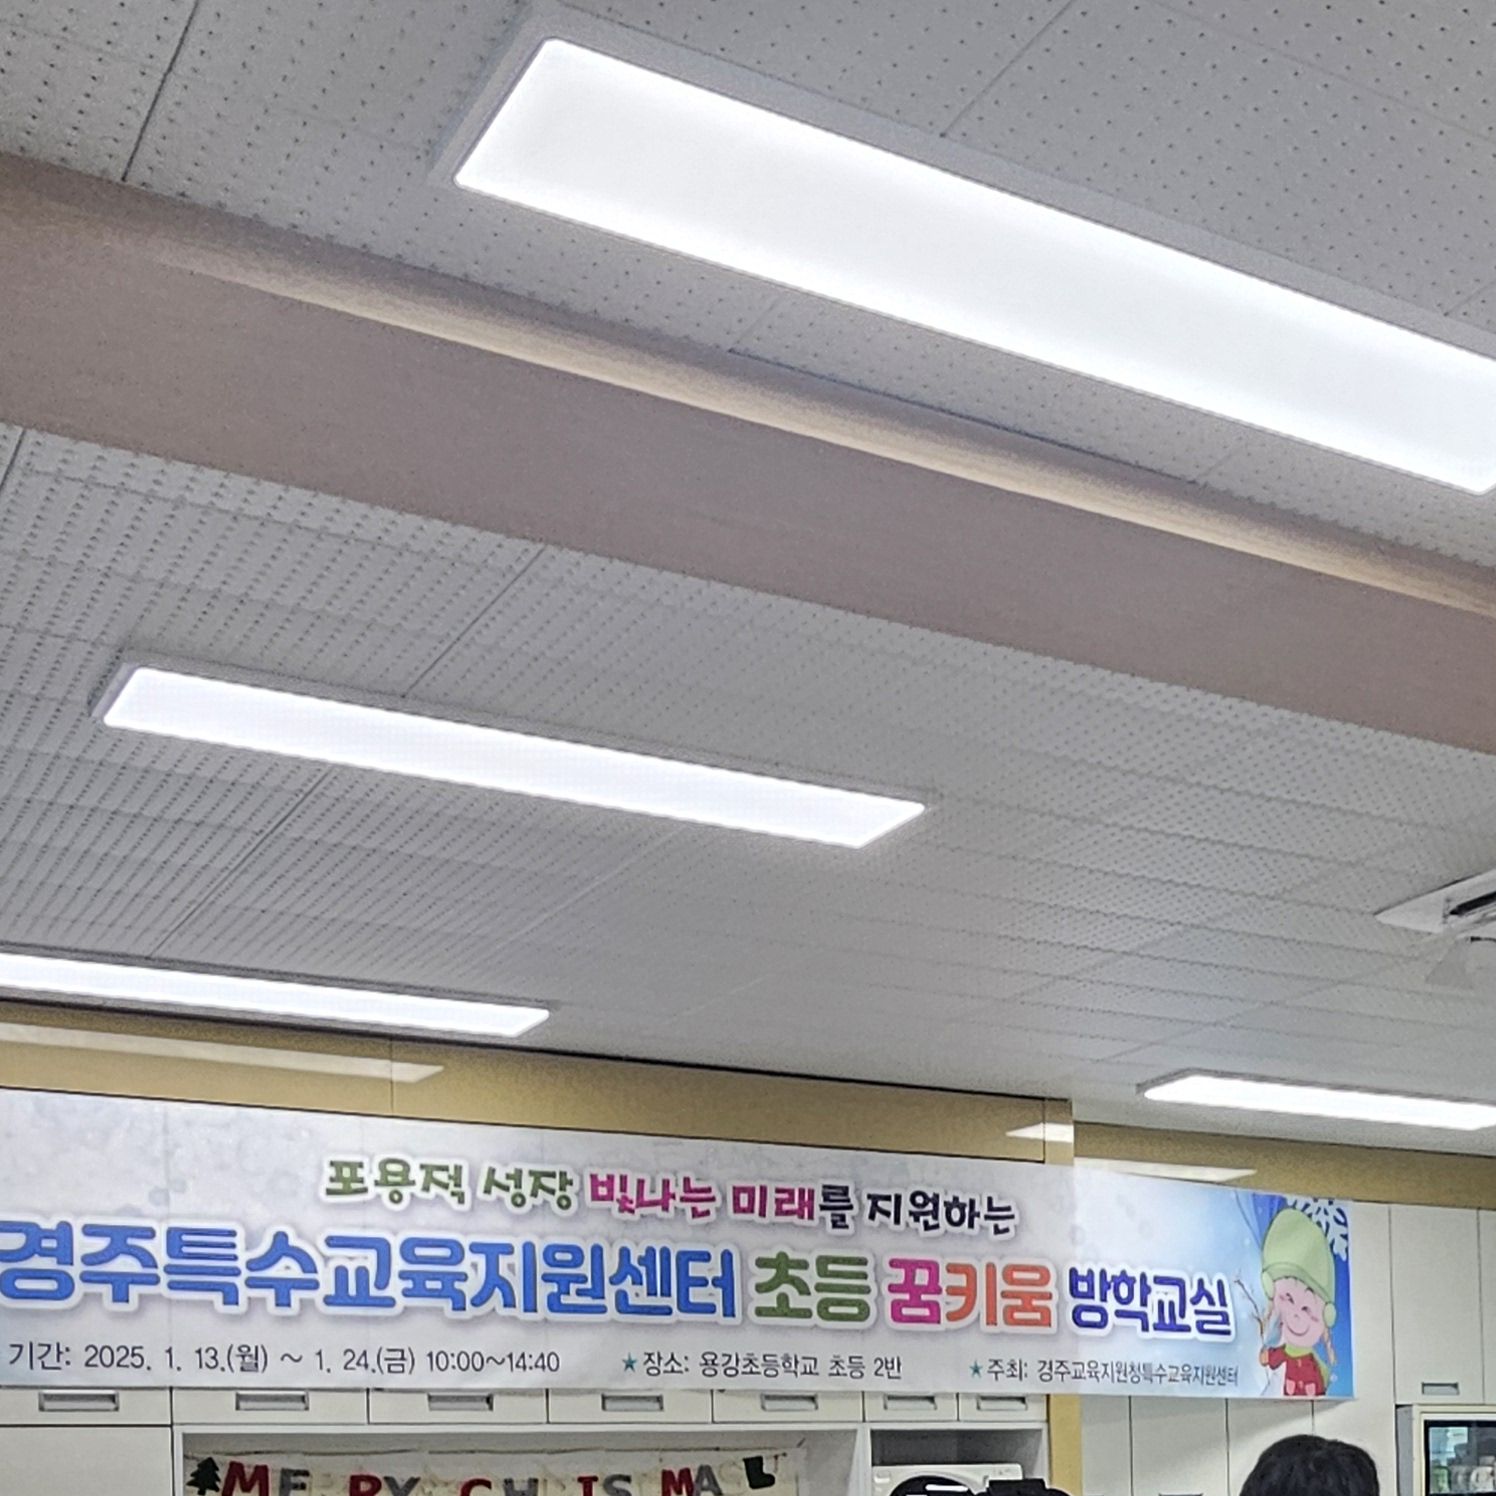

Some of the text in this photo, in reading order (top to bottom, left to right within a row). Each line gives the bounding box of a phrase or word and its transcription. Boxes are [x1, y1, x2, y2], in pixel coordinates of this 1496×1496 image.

[325, 1157, 1015, 1236] 포용적 성장 빛나는 미래를 지원하는
[0, 1220, 1232, 1336] 경주특수교육지원센터 초등 꿈키움 방학교실
[8, 1341, 71, 1371] 기간:
[83, 1344, 152, 1372] 2025.
[194, 1343, 268, 1373] 13.(월)
[342, 1346, 416, 1375] 24.(금)
[426, 1350, 561, 1374] 10:00~14:40
[642, 1351, 902, 1380] 장소: 용강초등학교 초등 2반
[986, 1358, 1239, 1388] 주최: 경주교육지원청특수교육지원센터
